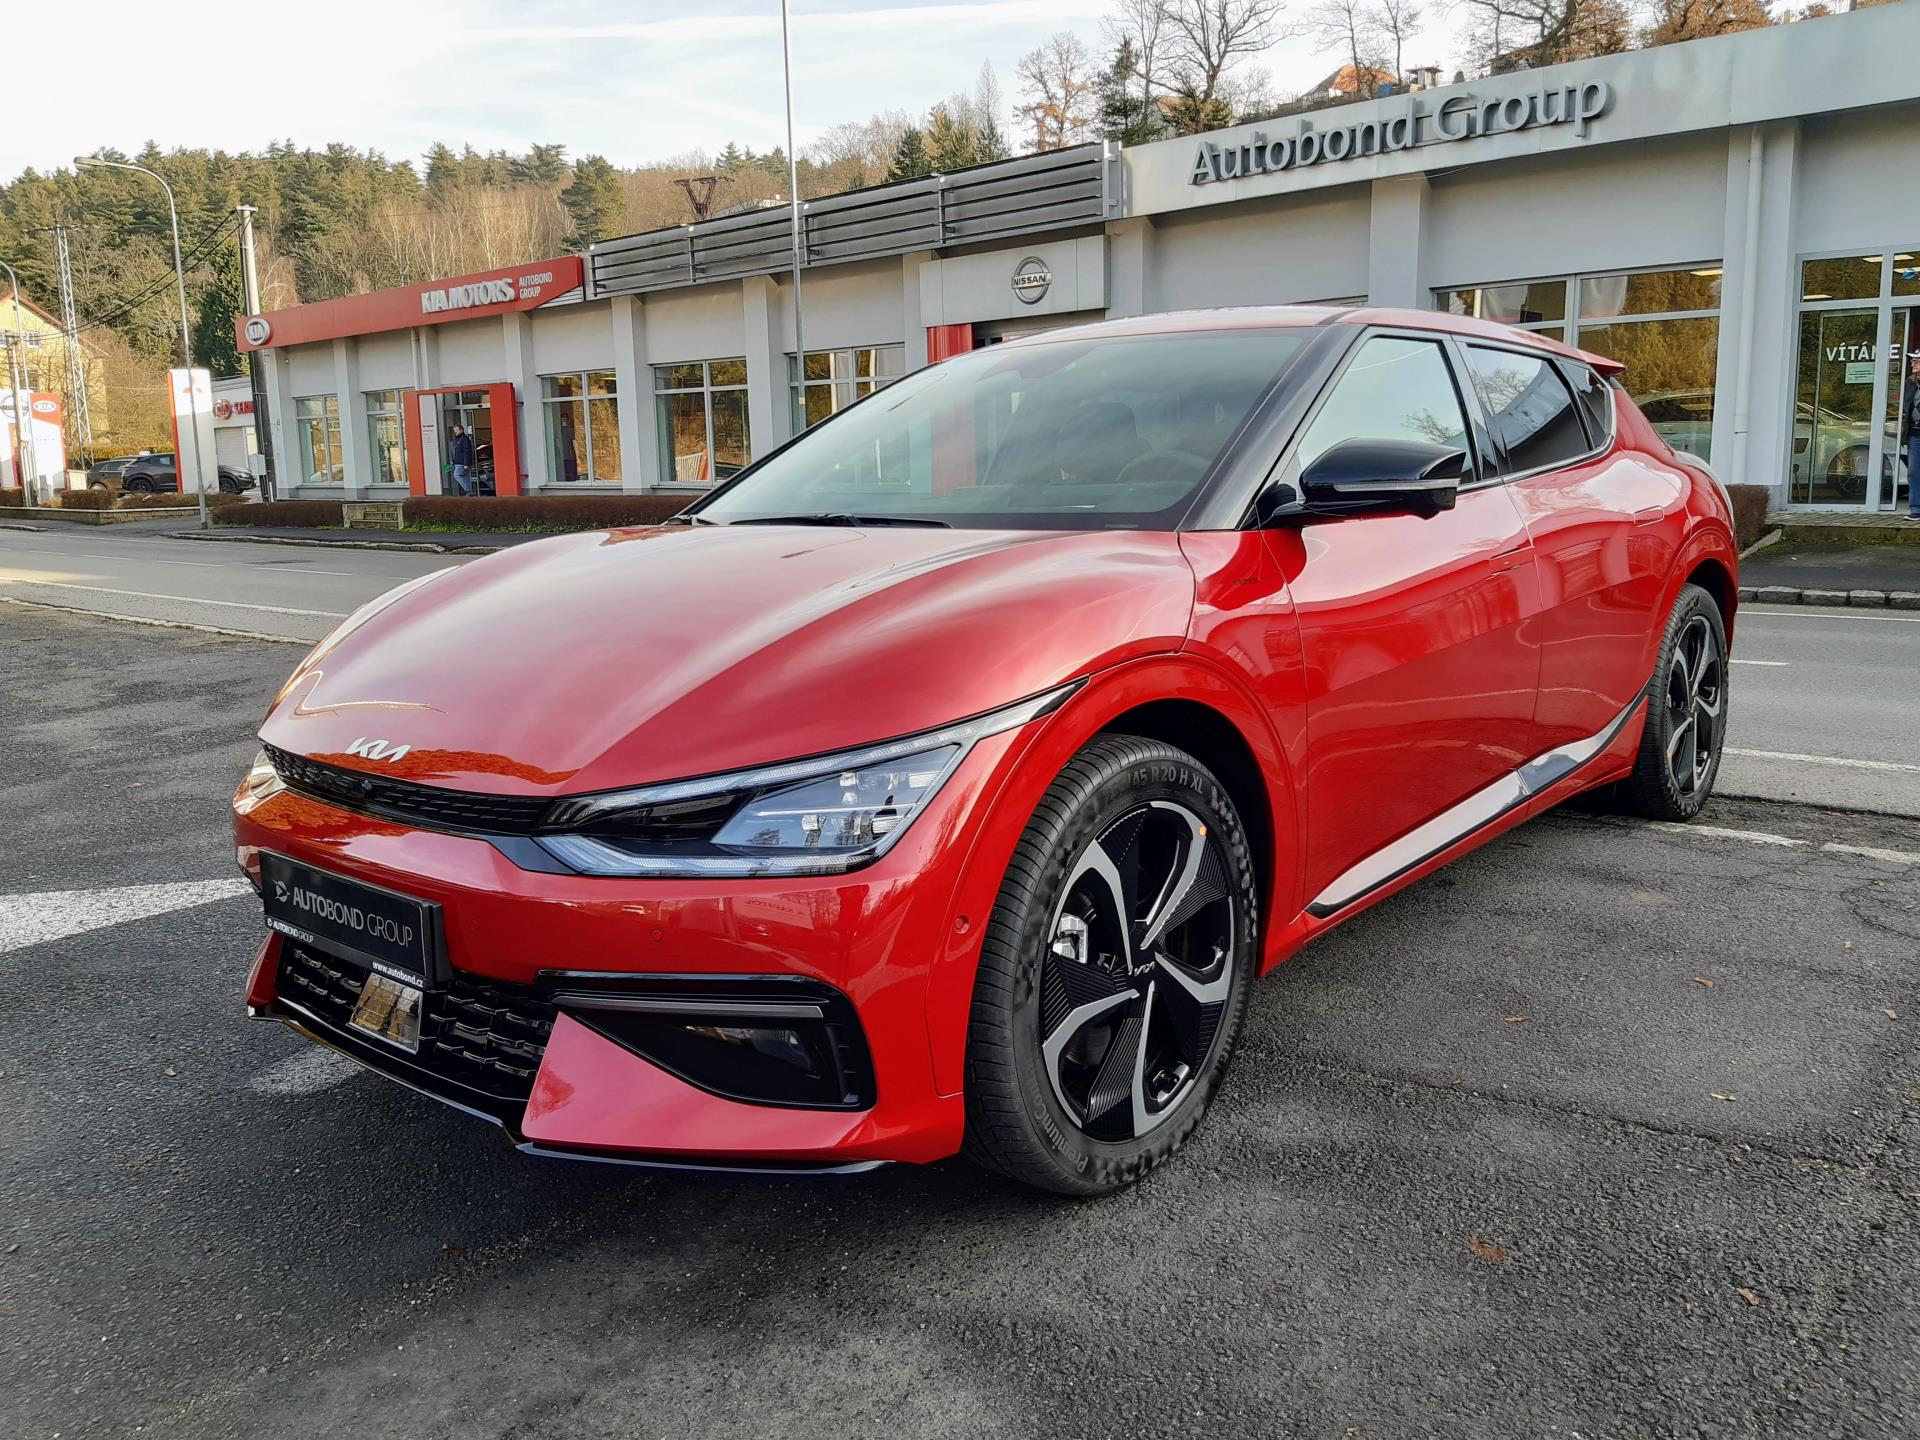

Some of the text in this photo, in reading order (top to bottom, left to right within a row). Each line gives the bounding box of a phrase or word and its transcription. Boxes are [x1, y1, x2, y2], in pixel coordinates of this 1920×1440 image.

[1188, 78, 1610, 186] Autobond Group
[519, 272, 553, 287] AUTOBOND
[1013, 274, 1047, 286] NISSAN
[421, 278, 516, 313] KIA MOTORS
[519, 287, 541, 300] GROUP
[344, 736, 411, 763] KIA
[292, 886, 413, 948] AUTOBOND GROUP
[273, 921, 314, 943] AUTOBOND GROUP
[372, 961, 424, 989] www.autobond.cz
